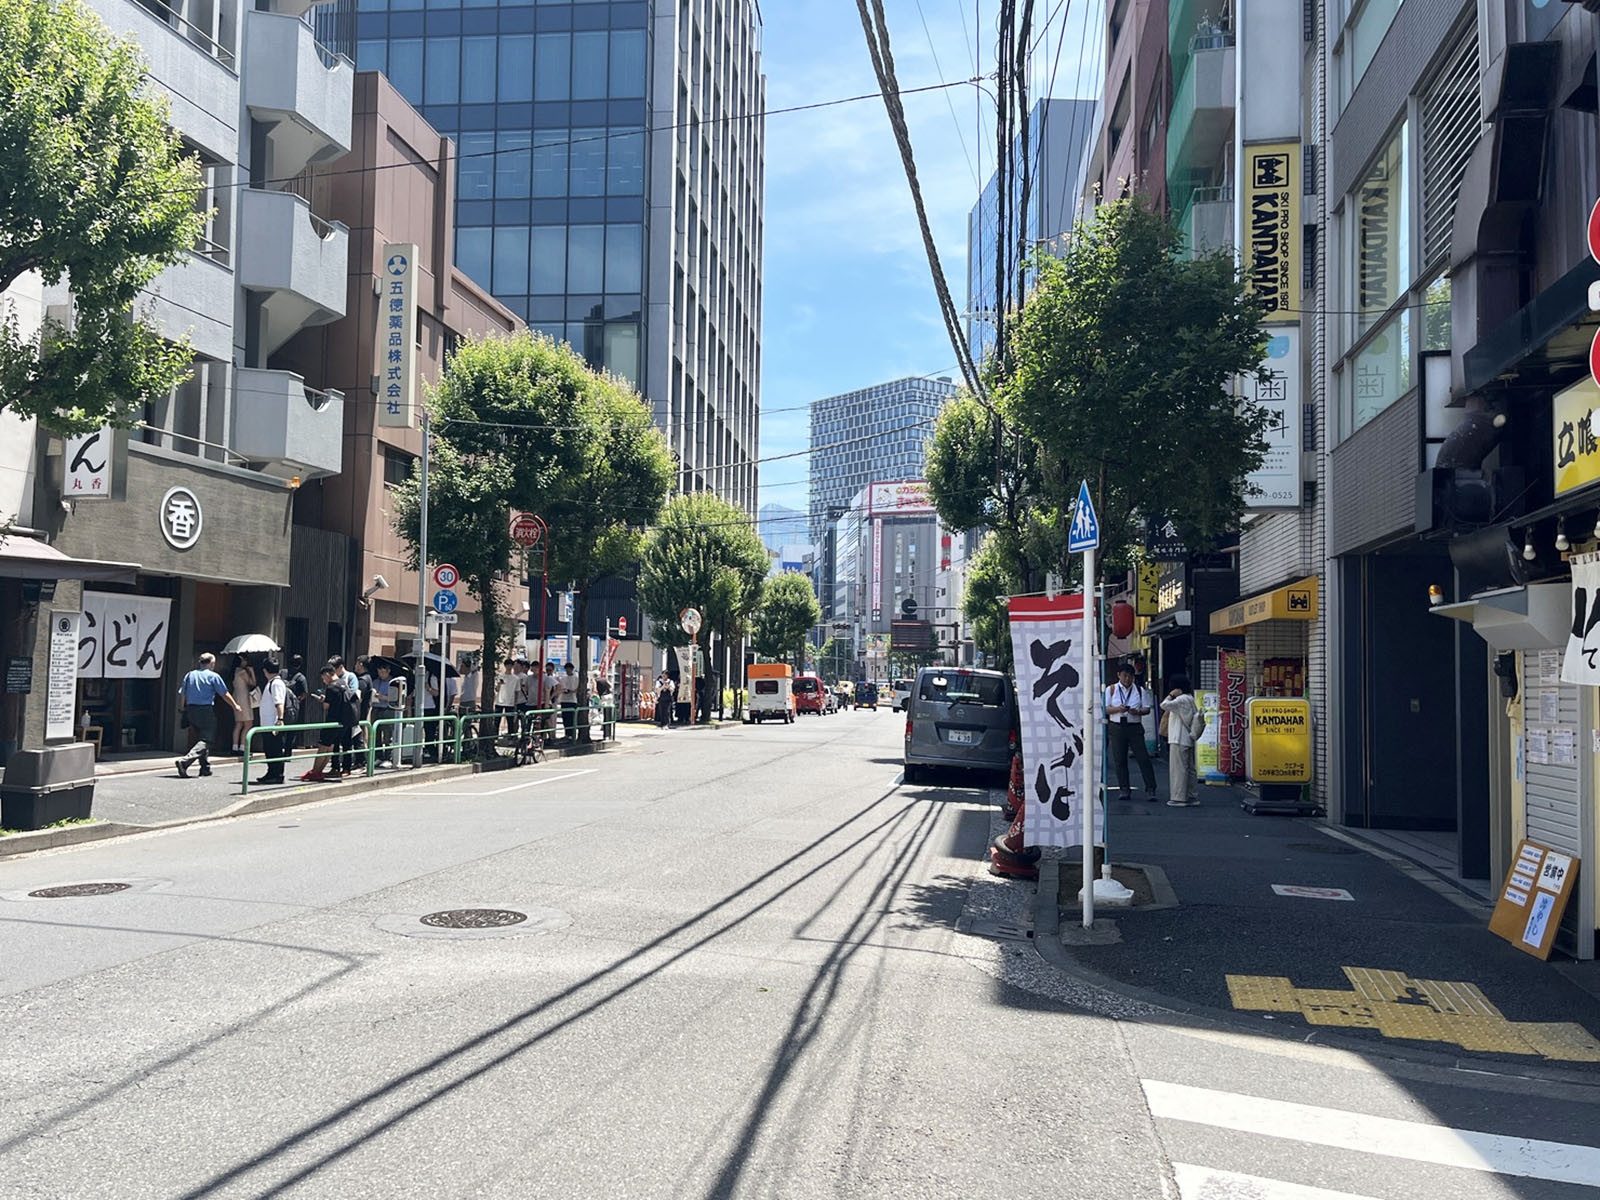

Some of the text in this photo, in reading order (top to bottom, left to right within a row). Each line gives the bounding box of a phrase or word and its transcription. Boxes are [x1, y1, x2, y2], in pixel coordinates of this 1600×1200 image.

[1280, 192, 1290, 311] SKI PRO SHOP SINCE 1987
[387, 281, 404, 415] 五徳薬品株式会社
[168, 499, 195, 539] 香
[1160, 520, 1178, 538] 食
[440, 571, 454, 582] 30
[78, 610, 164, 670] うどん
[1227, 673, 1246, 773] アウトレット
[1255, 716, 1304, 726] KANDAHAR
